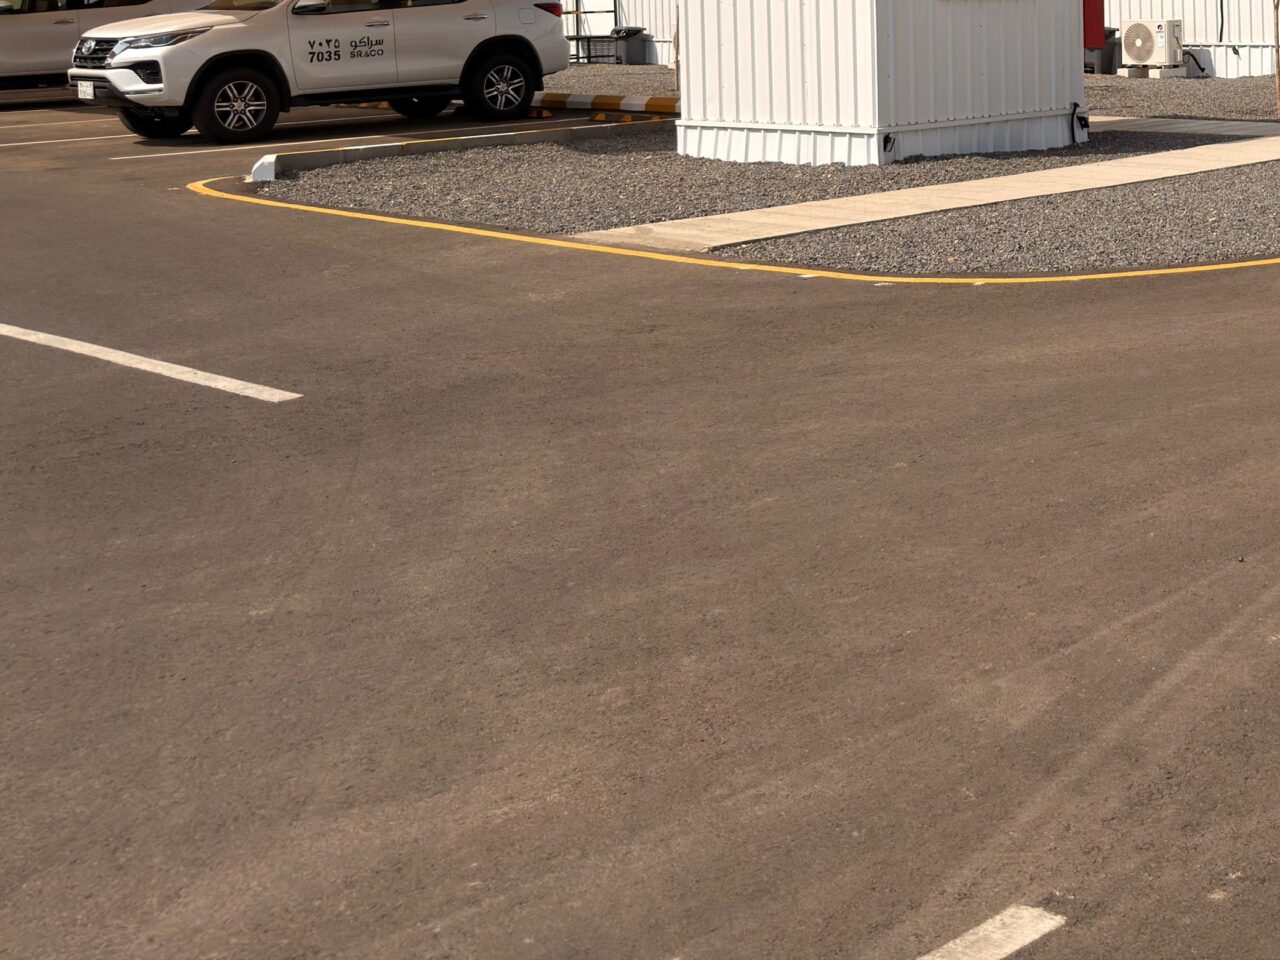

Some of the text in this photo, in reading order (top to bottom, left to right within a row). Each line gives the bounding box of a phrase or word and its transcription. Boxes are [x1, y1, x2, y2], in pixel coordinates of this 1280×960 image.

[308, 38, 341, 50] ٧٠٣٥
[350, 36, 384, 50] سراكو
[308, 50, 341, 63] 7035
[350, 49, 384, 59] SRACO
